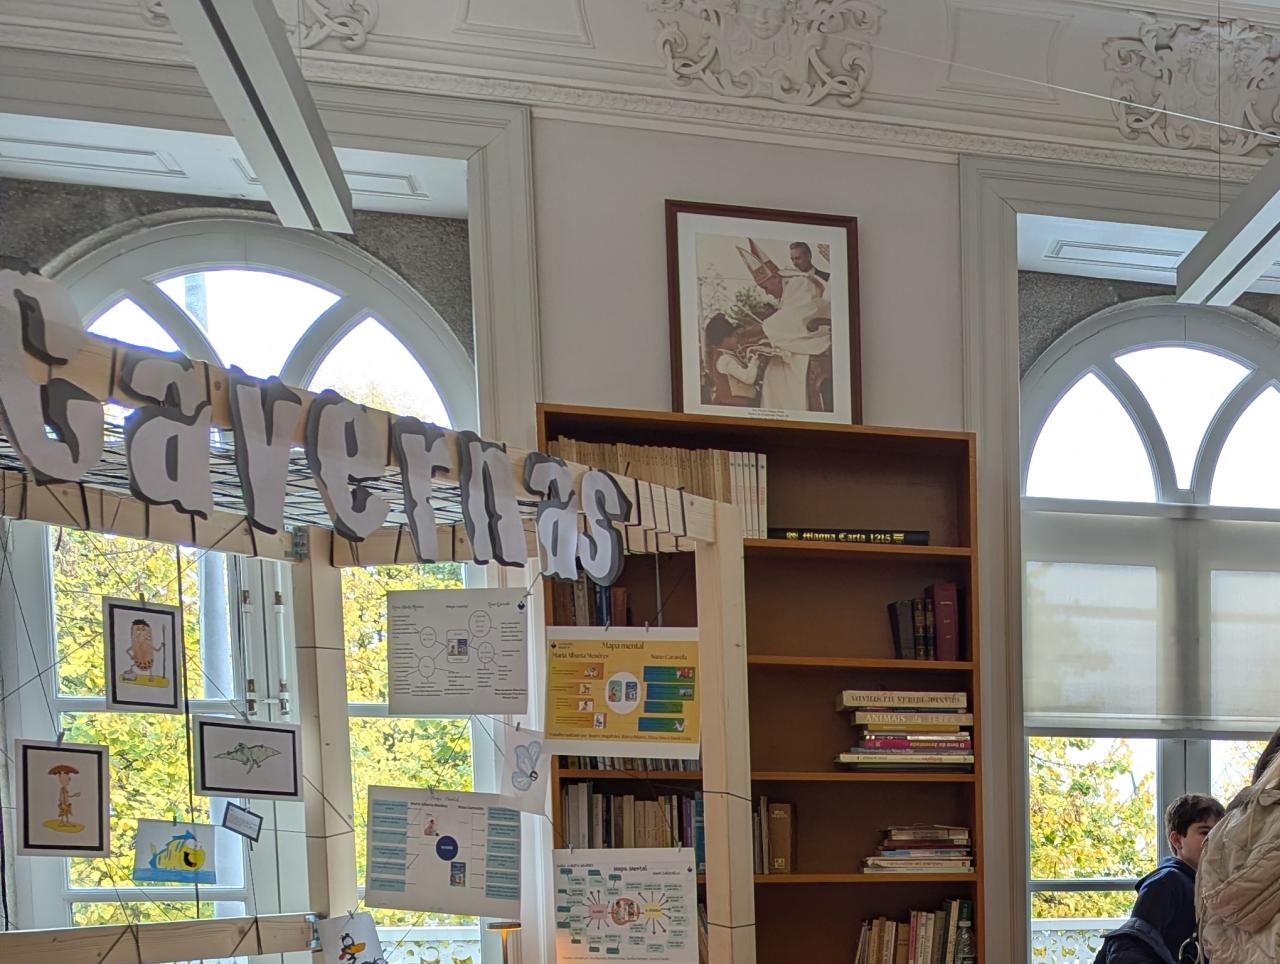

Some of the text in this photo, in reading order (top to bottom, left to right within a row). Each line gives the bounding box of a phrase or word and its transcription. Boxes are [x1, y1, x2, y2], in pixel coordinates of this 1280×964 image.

[838, 532, 866, 543] Carta
[870, 533, 892, 544] 1215
[601, 641, 645, 653] Mapa mental
[866, 713, 905, 723] ANIMAIS
